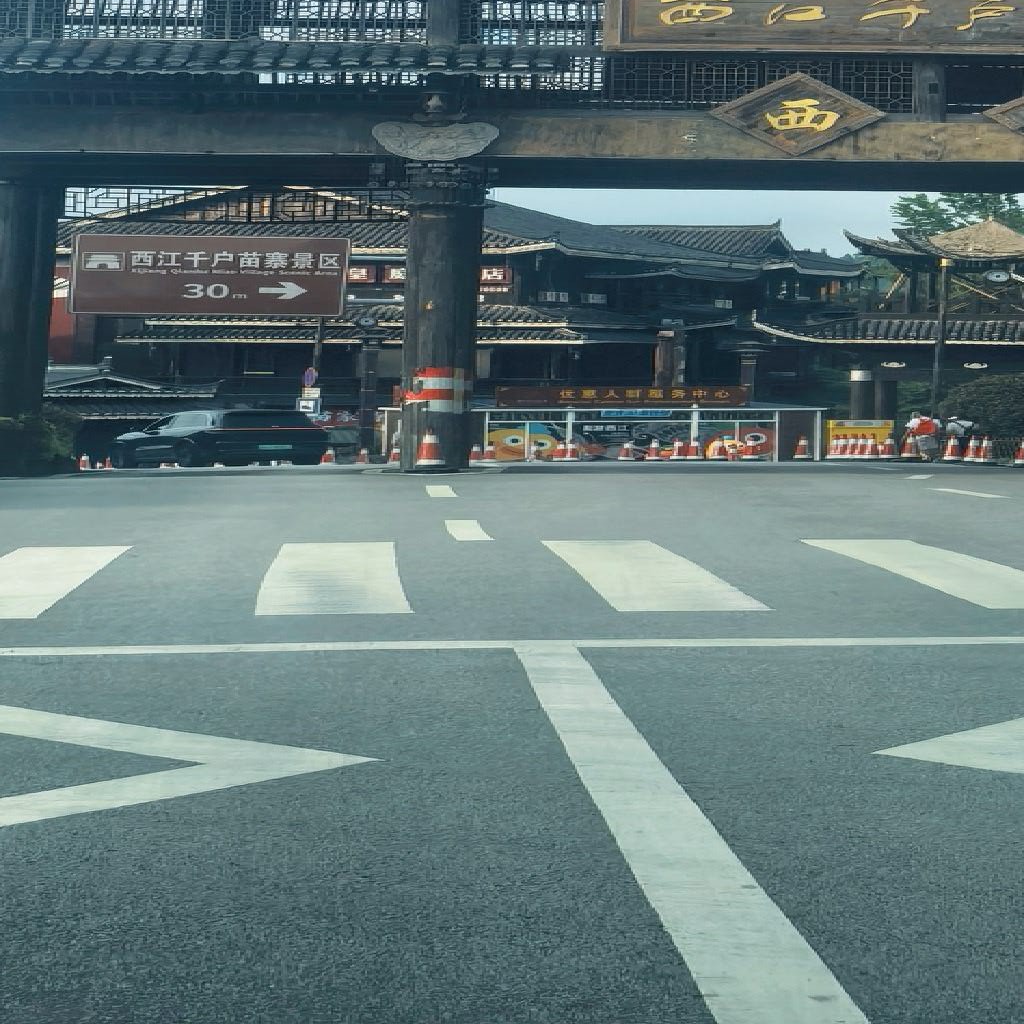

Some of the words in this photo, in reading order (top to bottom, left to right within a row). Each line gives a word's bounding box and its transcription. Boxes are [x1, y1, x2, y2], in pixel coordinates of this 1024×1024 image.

[765, 99, 841, 131] 西
[130, 249, 341, 269] 西江千户苗寨景区
[183, 283, 230, 299] 30
